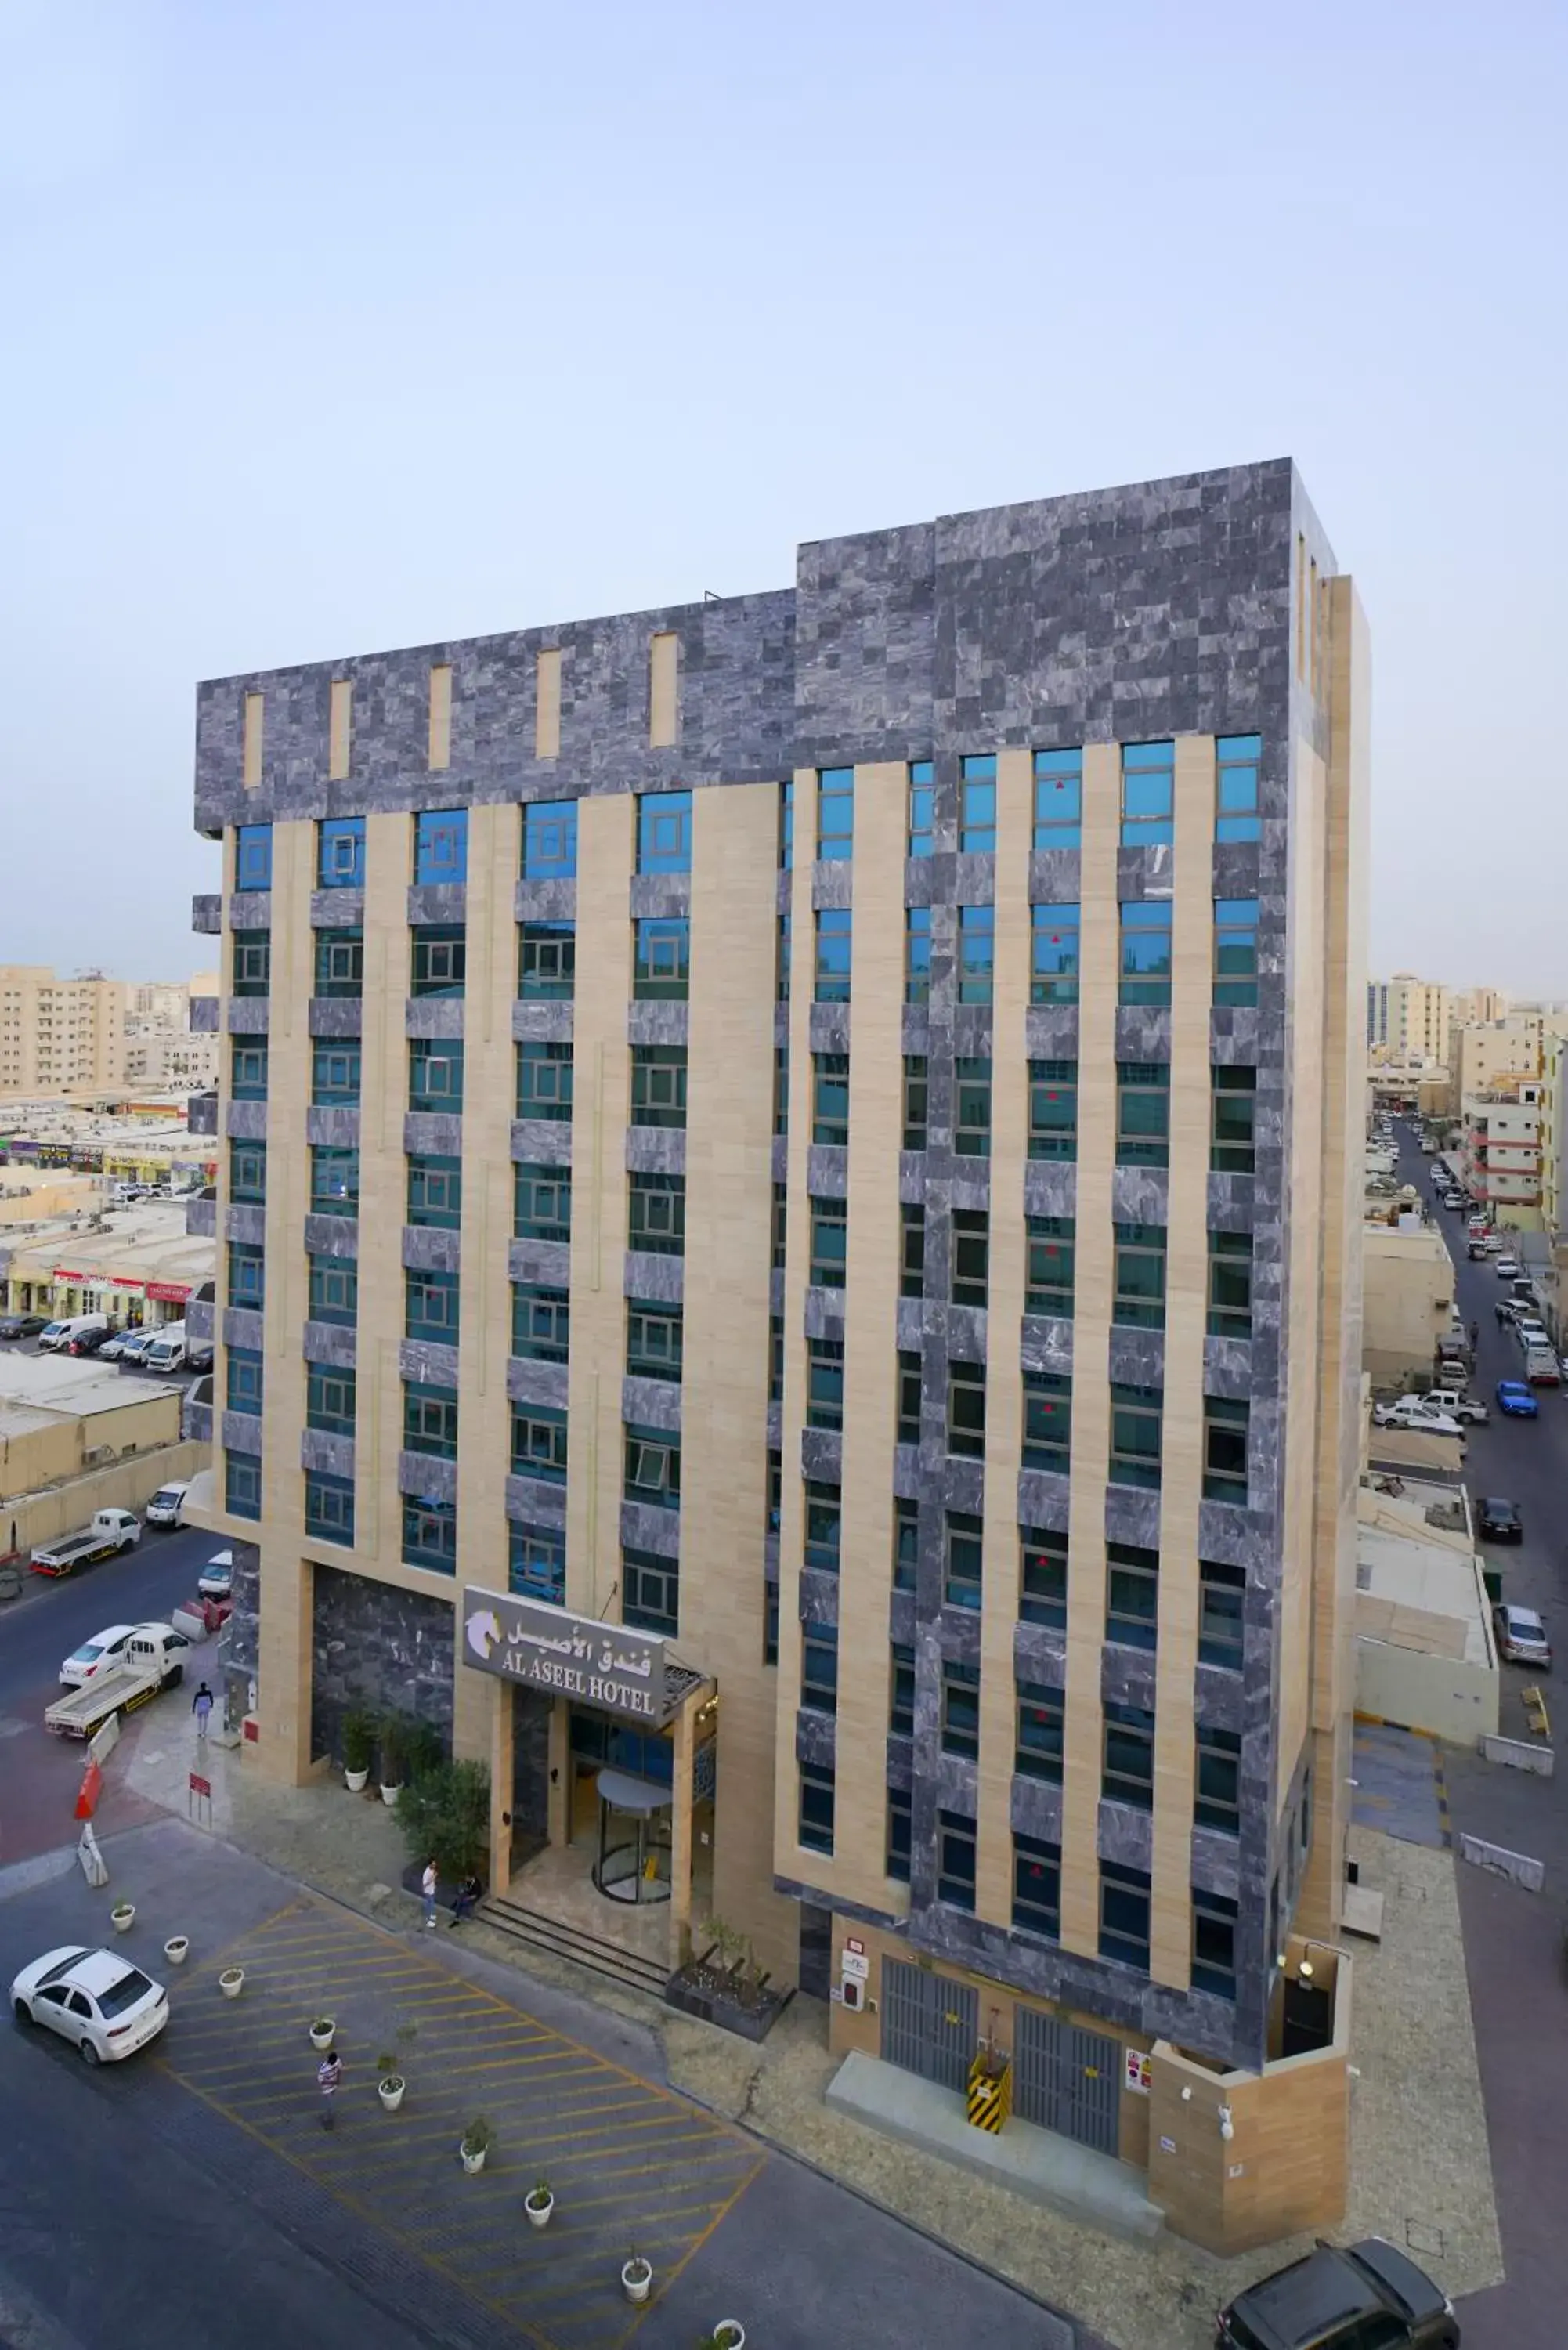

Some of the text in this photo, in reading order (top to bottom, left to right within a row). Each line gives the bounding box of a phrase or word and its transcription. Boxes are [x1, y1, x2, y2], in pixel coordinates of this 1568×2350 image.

[501, 1650, 655, 1716] AL ASEEL HOTEL
[598, 1639, 652, 1678] فندق
